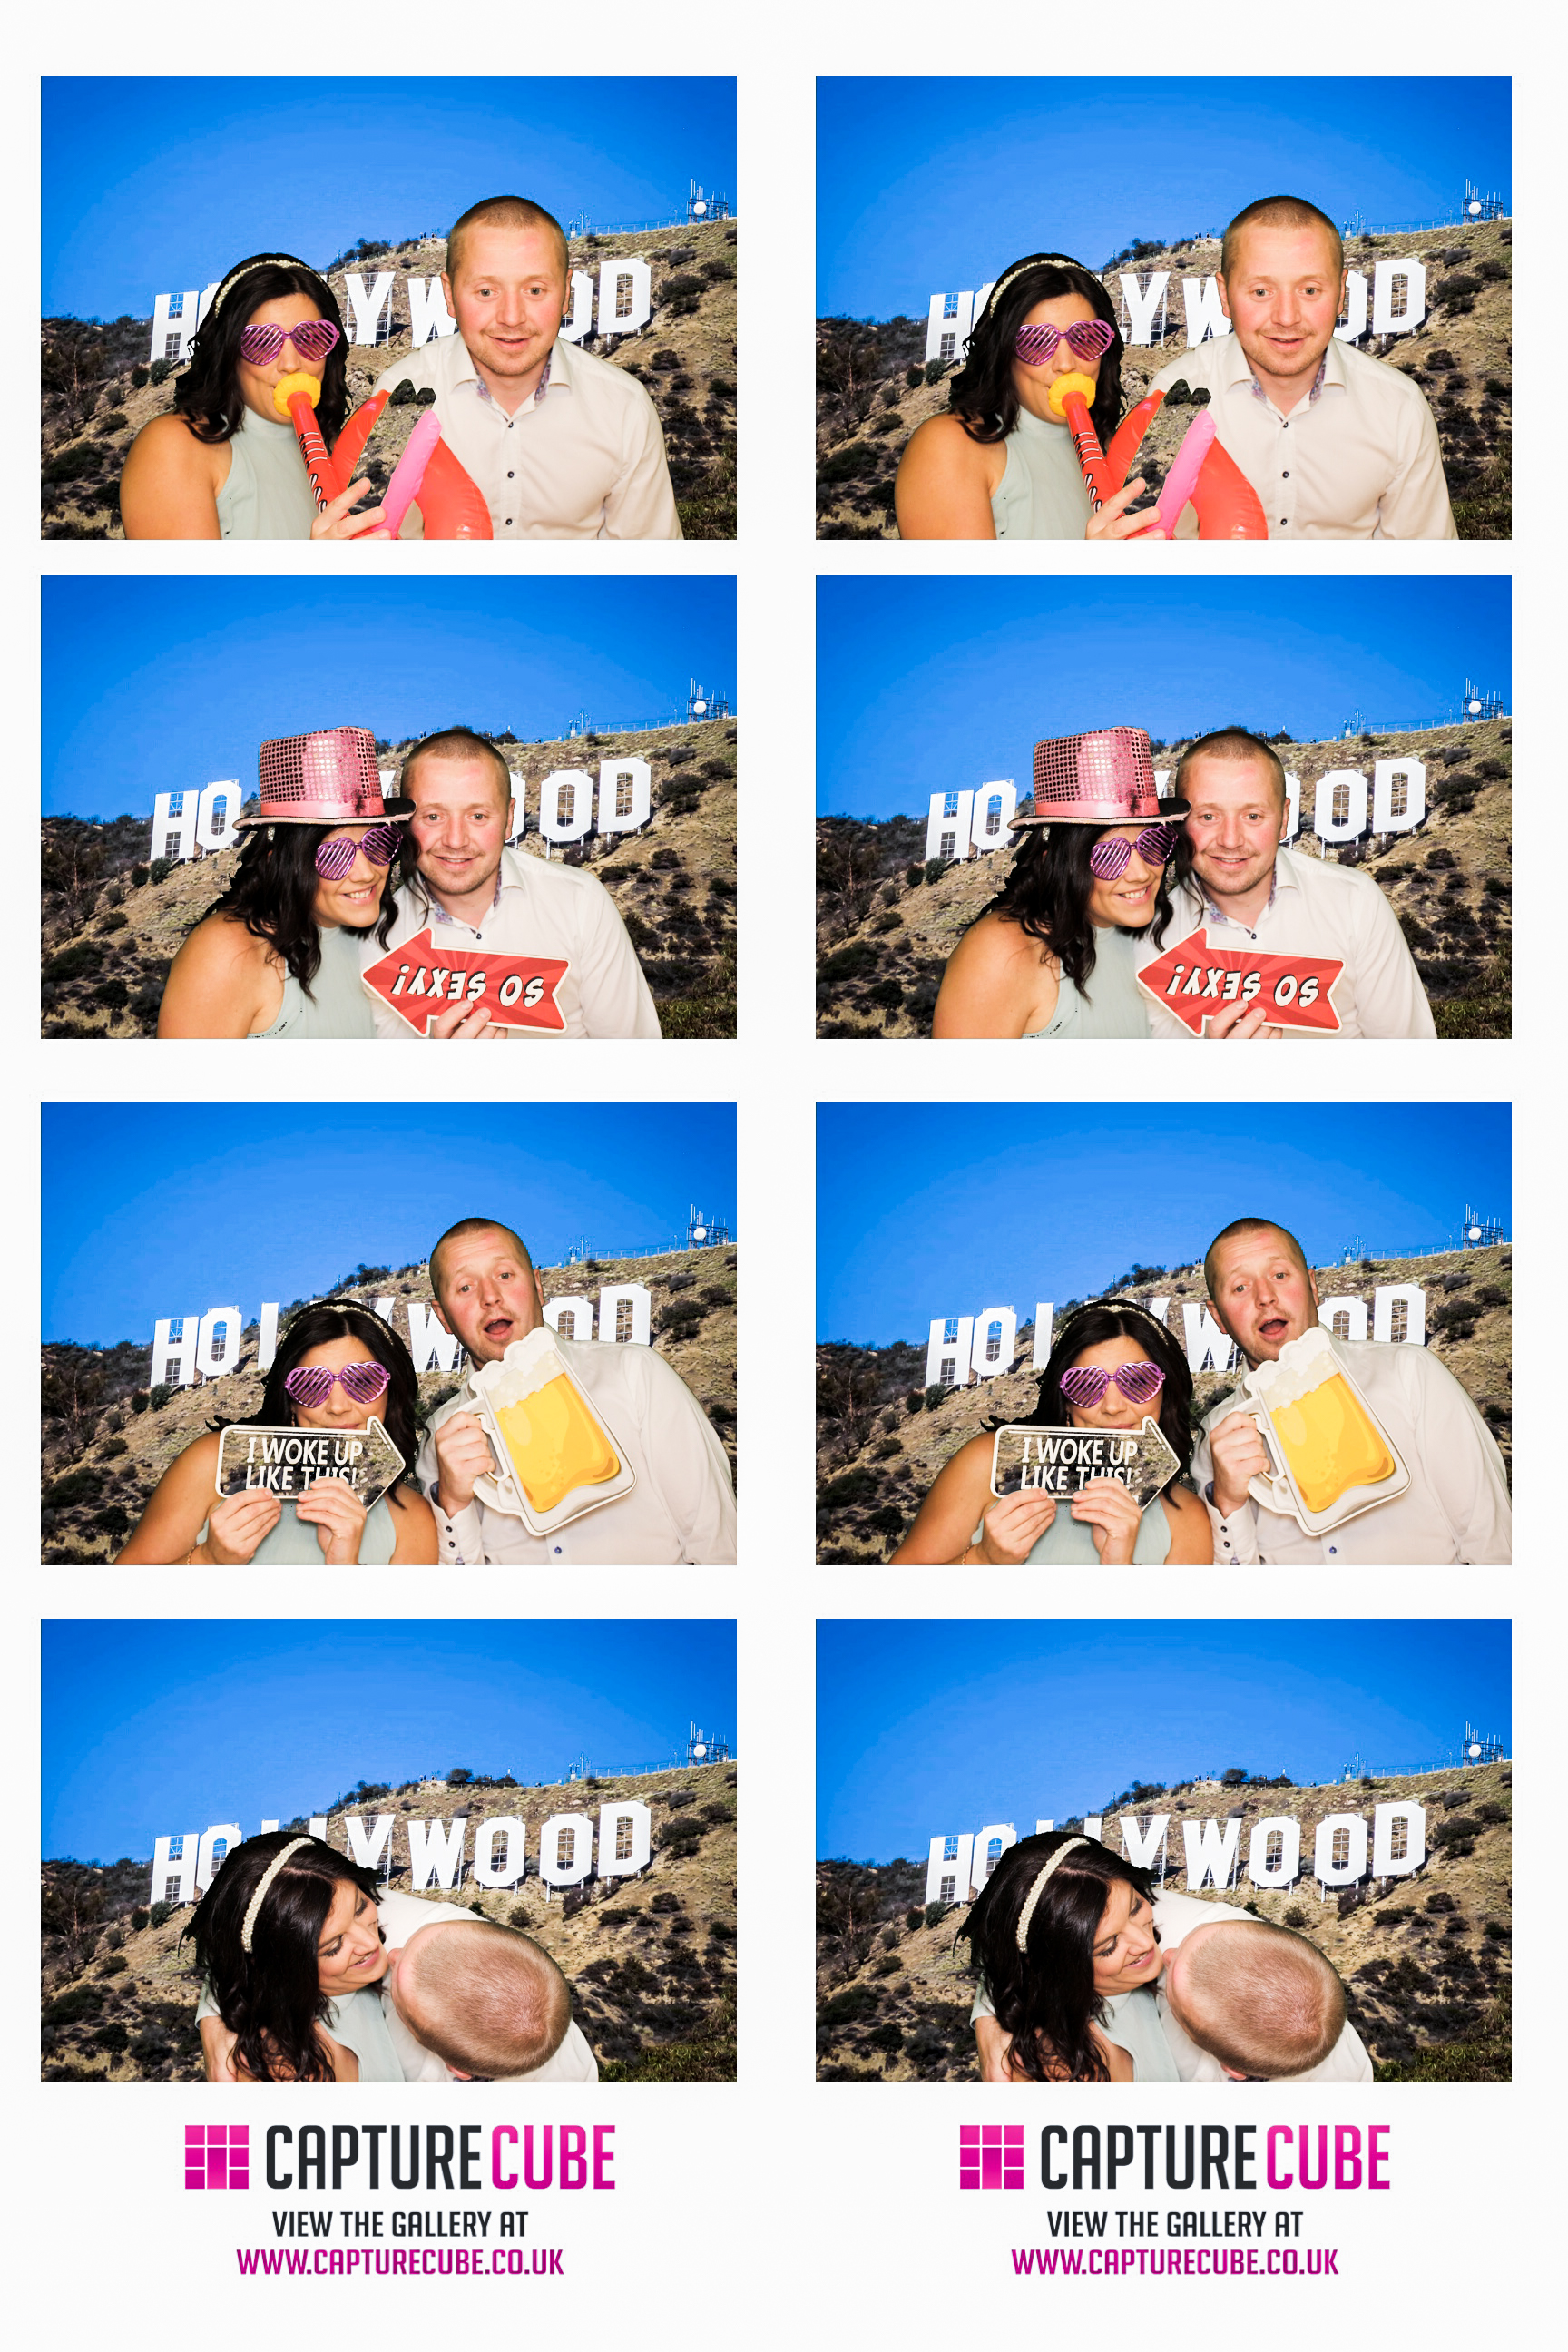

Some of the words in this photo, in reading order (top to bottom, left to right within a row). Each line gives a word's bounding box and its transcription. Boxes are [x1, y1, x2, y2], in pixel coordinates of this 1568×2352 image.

[390, 964, 487, 1002] SEXY!
[498, 973, 544, 1007] SO
[1165, 964, 1262, 1002] SEXY!
[1273, 973, 1319, 1007] SO
[246, 1436, 257, 1464] I
[261, 1437, 329, 1465] WOKE
[334, 1440, 363, 1465] UP
[1021, 1436, 1032, 1464] I
[1036, 1437, 1104, 1465] WOKE
[1109, 1440, 1138, 1465] UP
[245, 1465, 293, 1491] LIKE
[1020, 1465, 1068, 1491] LIKE
[151, 1800, 651, 1904] HOYWOOD
[926, 1800, 1426, 1904] HOYWOOD
